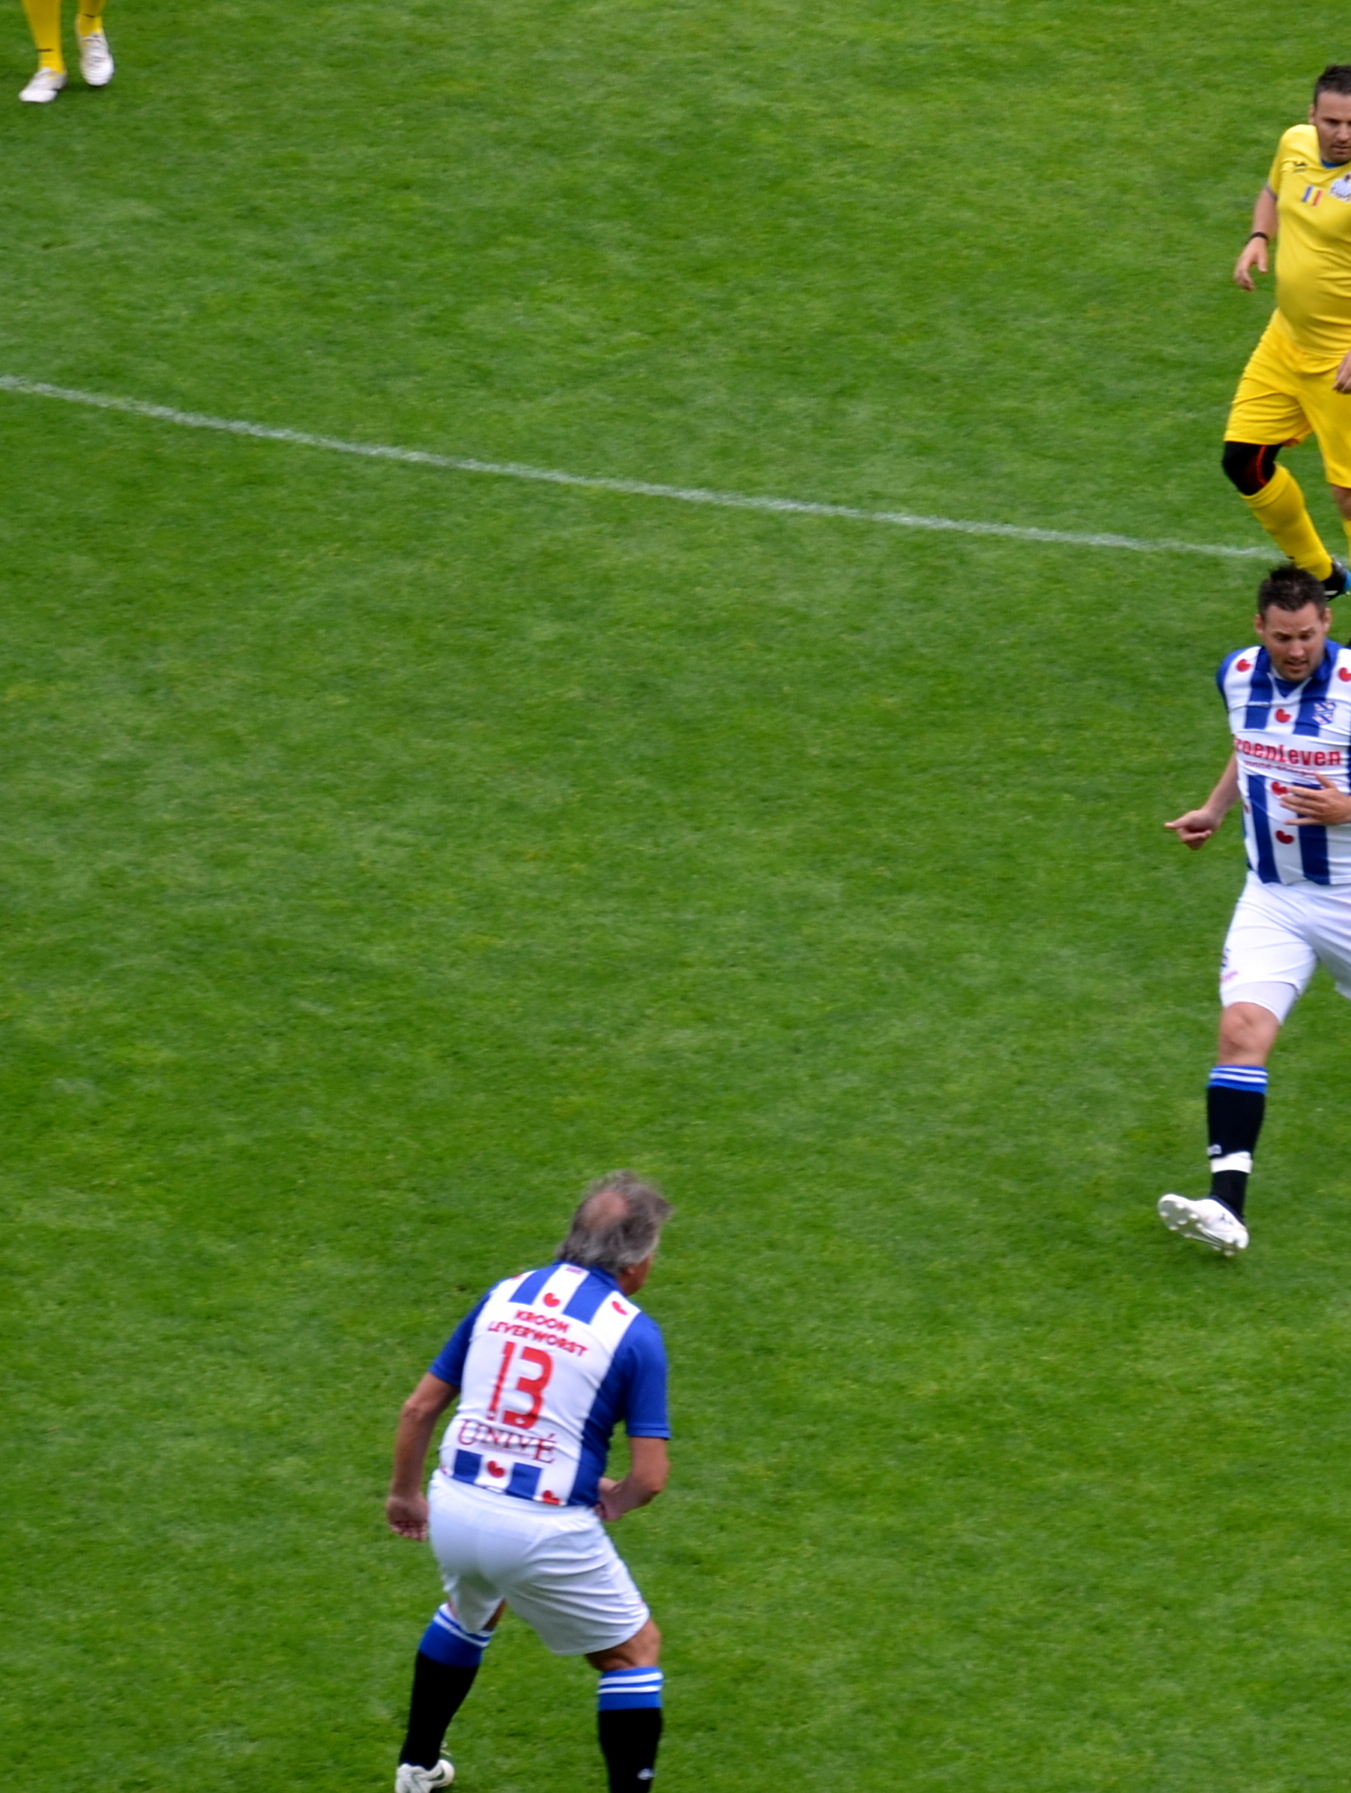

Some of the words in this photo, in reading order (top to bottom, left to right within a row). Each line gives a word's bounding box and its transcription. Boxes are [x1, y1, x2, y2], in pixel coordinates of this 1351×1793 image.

[1235, 738, 1342, 766] roenleven
[514, 1309, 570, 1333] KROOM
[487, 1321, 588, 1357] LEVERWORST
[486, 1340, 554, 1430] 13
